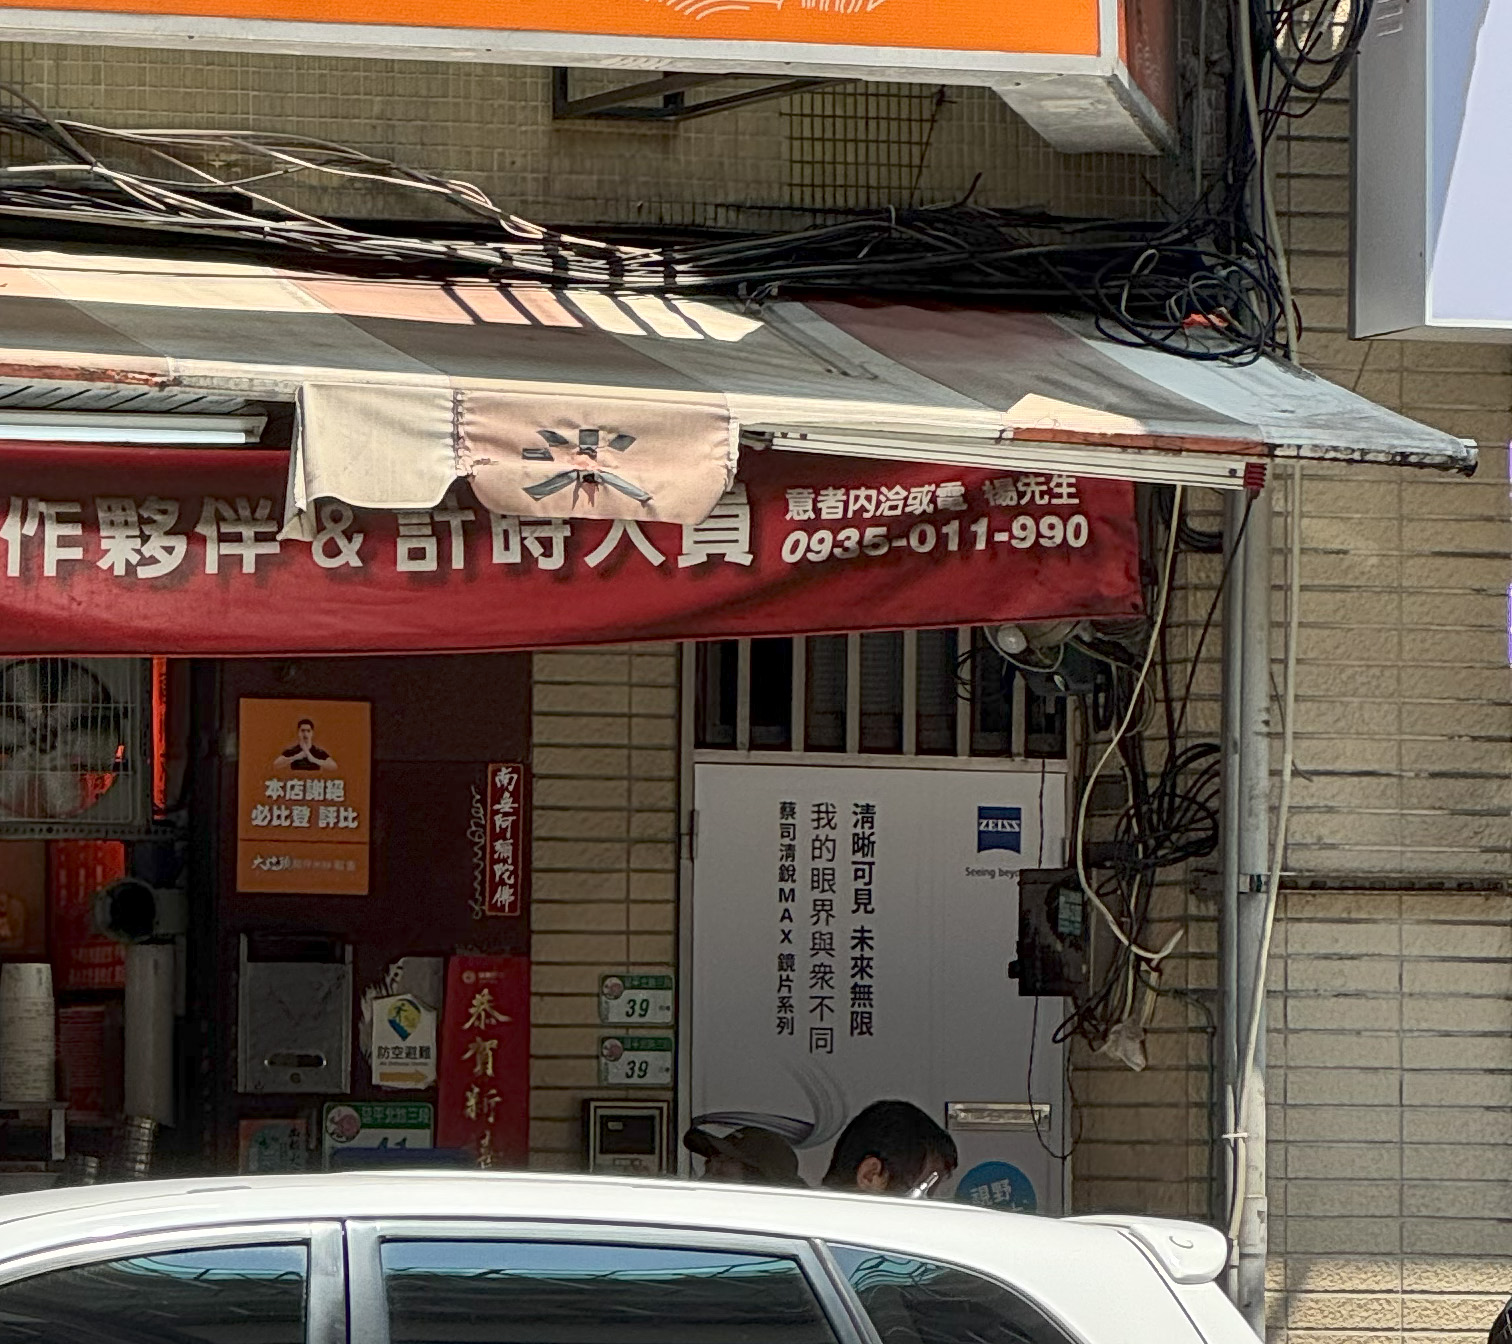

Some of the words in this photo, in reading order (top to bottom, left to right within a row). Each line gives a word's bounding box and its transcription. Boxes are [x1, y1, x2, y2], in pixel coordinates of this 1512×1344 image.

[982, 474, 1080, 507] 楊先生
[311, 501, 364, 570] &
[780, 513, 1089, 564] 0935-011-990
[265, 778, 345, 802] 本店謝絕
[251, 804, 312, 827] 必比登
[318, 805, 360, 829] 評比
[979, 819, 1020, 832] ZEISS
[850, 802, 877, 915] 清晰可見
[964, 866, 996, 880] Seeing
[998, 867, 1019, 880] bey
[849, 924, 875, 1037] 未來無限
[777, 953, 796, 1036] 鏡片系列
[625, 999, 649, 1017] 39
[377, 1045, 431, 1060] 防空避難
[625, 1060, 648, 1078] 39
